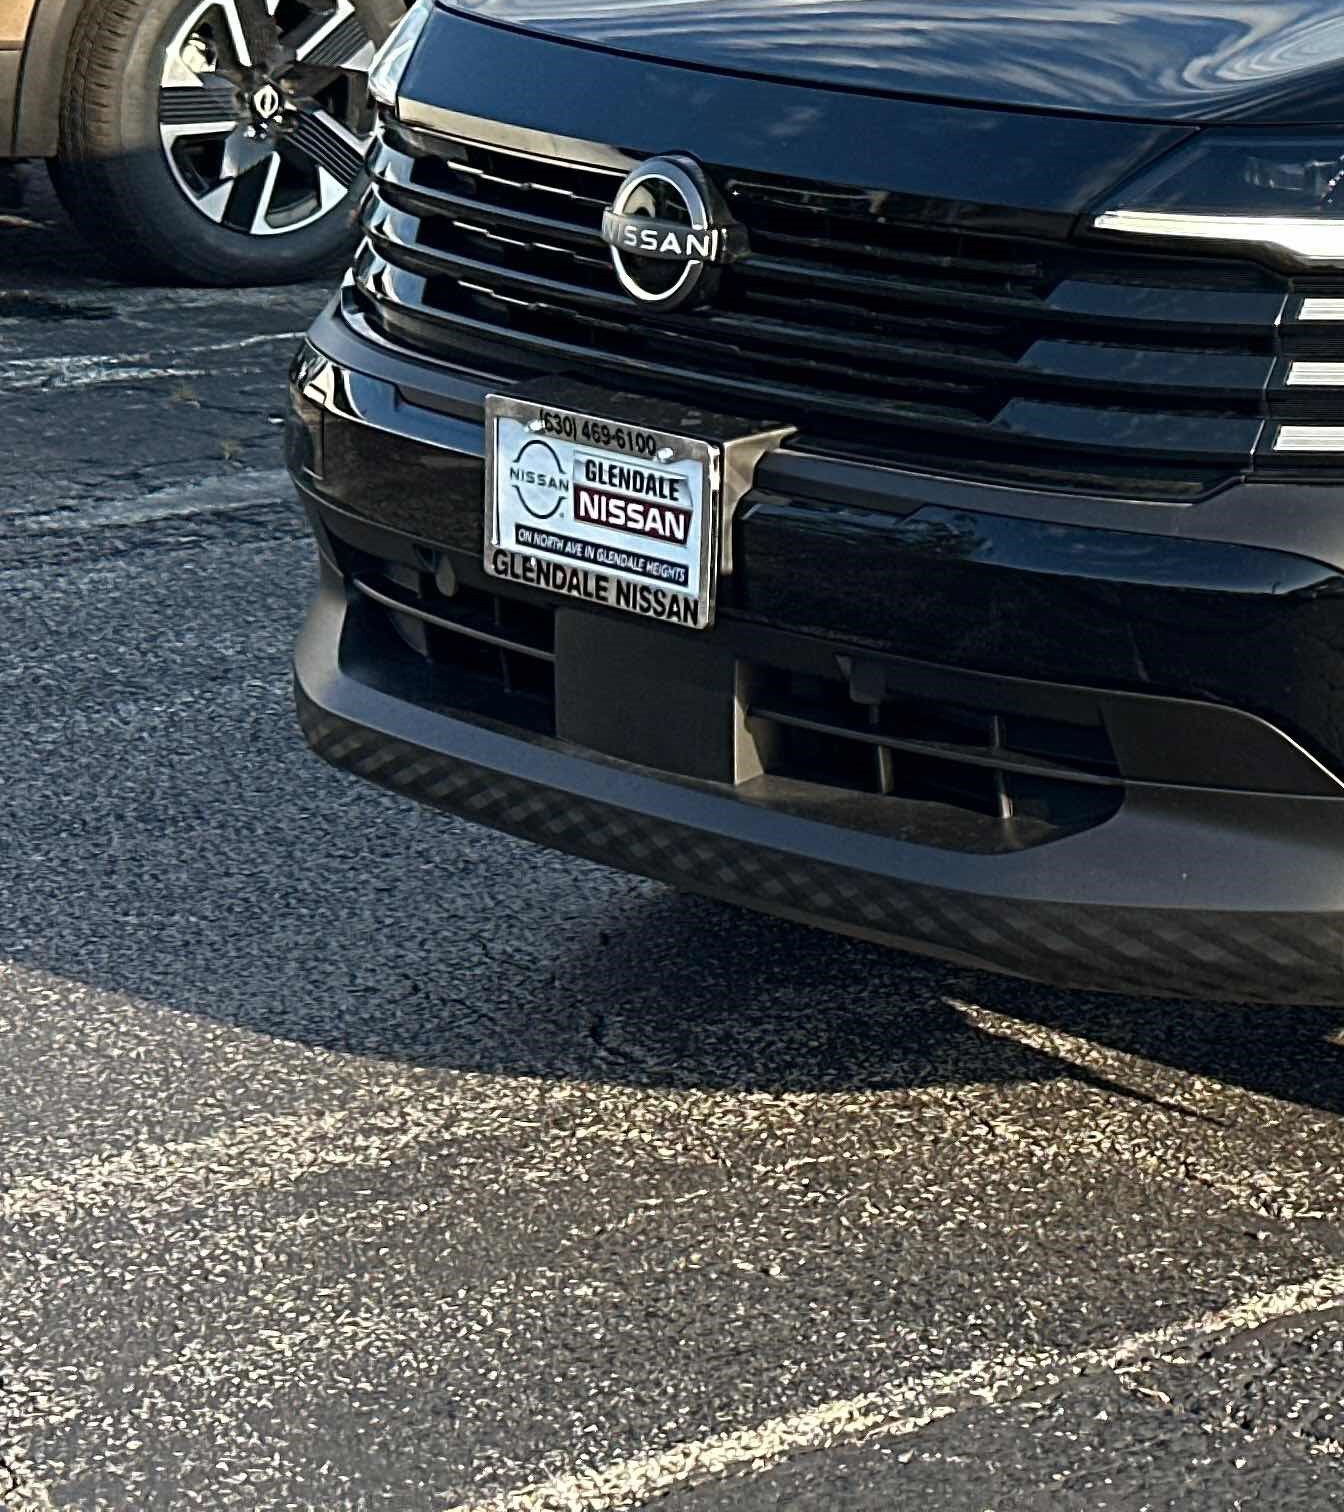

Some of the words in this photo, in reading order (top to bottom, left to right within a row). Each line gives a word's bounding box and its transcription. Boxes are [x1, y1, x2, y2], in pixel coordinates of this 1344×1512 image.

[603, 218, 710, 257] NISSAN
[581, 420, 657, 456] 469-6100
[509, 466, 570, 492] NISSAN
[584, 459, 681, 501] GLENDALE
[578, 490, 685, 540] NISSAN
[518, 528, 533, 543] ON
[533, 533, 564, 552] NORTH
[564, 541, 584, 557] AVE
[584, 545, 595, 561] IN
[596, 548, 645, 573] GLENDALE
[646, 561, 686, 583] HEIGHTS
[492, 549, 610, 603] GLENDALE
[615, 581, 700, 627] NISSAN
